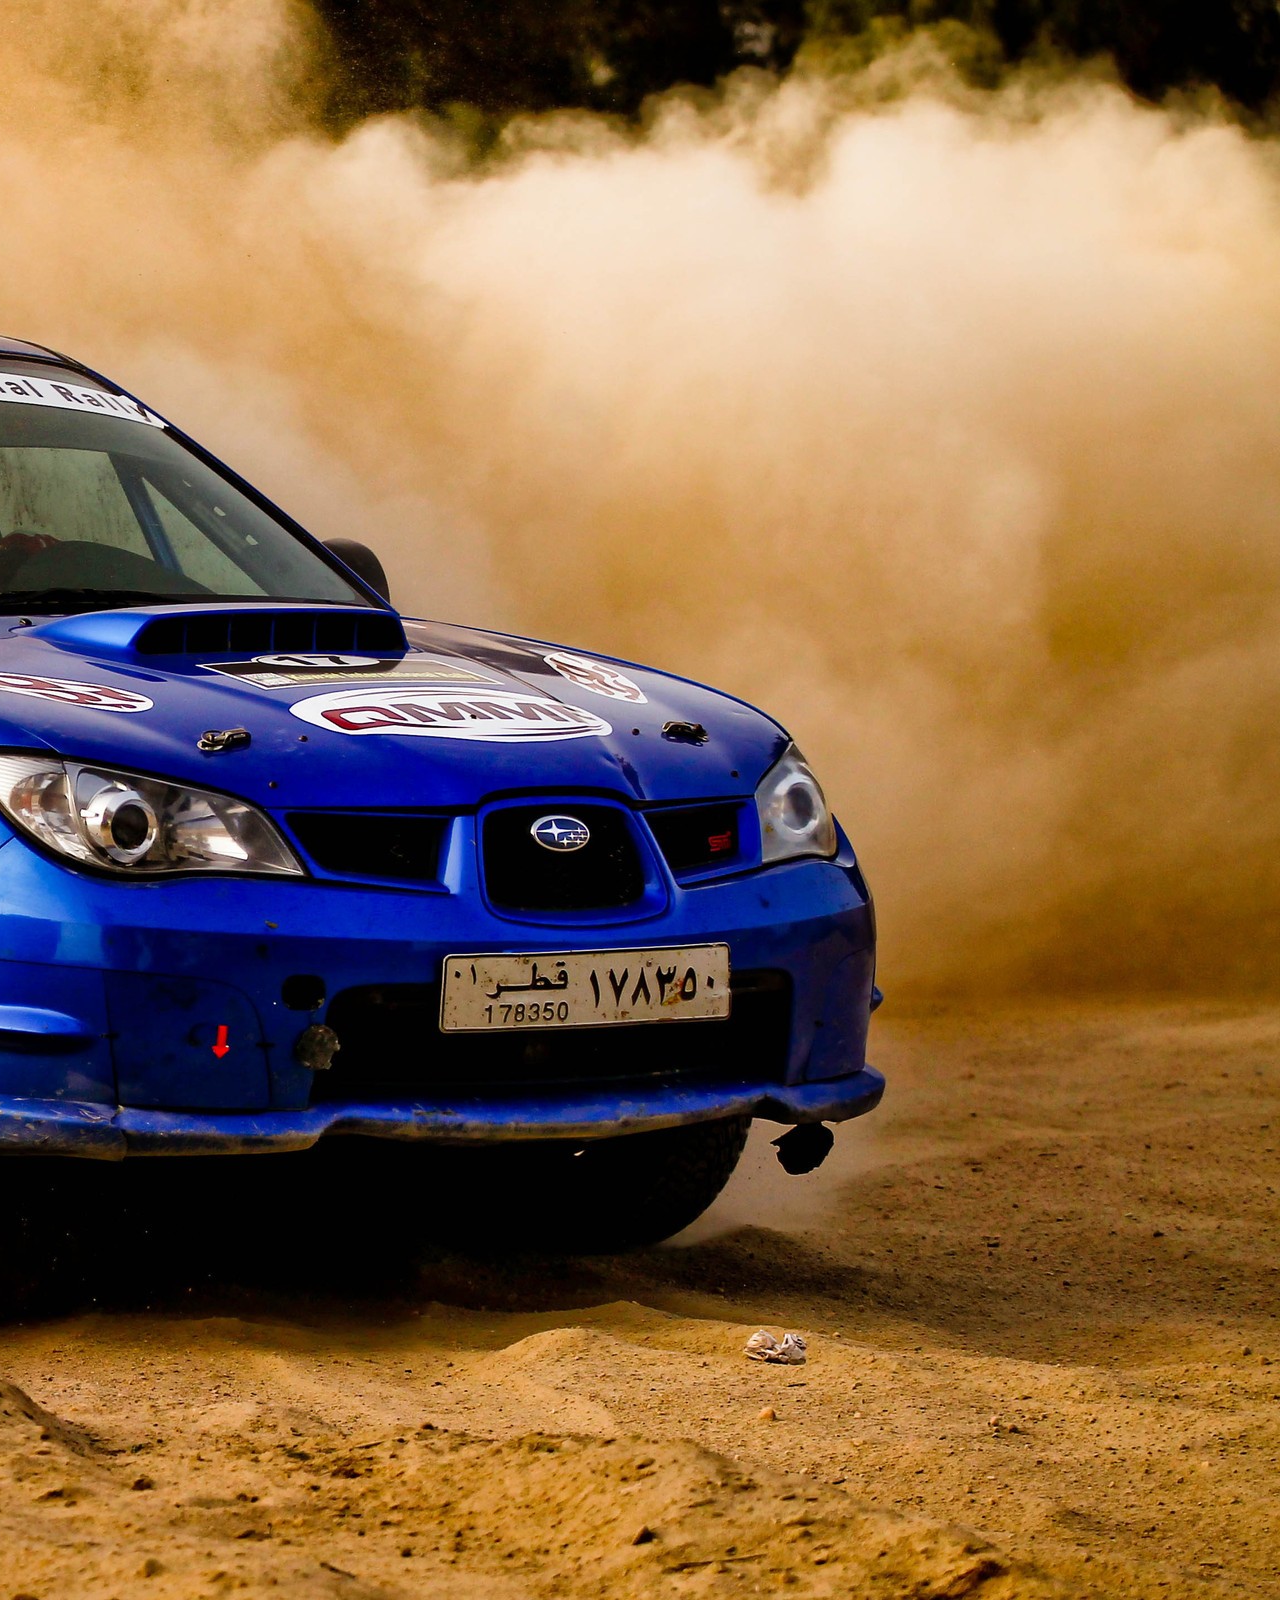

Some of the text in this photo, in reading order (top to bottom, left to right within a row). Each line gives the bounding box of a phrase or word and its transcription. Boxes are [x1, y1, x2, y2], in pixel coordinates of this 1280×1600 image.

[49, 383, 152, 423] Rally
[272, 655, 350, 666] 17
[320, 701, 597, 731] QMMF
[485, 960, 570, 999] قطر
[484, 1000, 570, 1024] 178350
